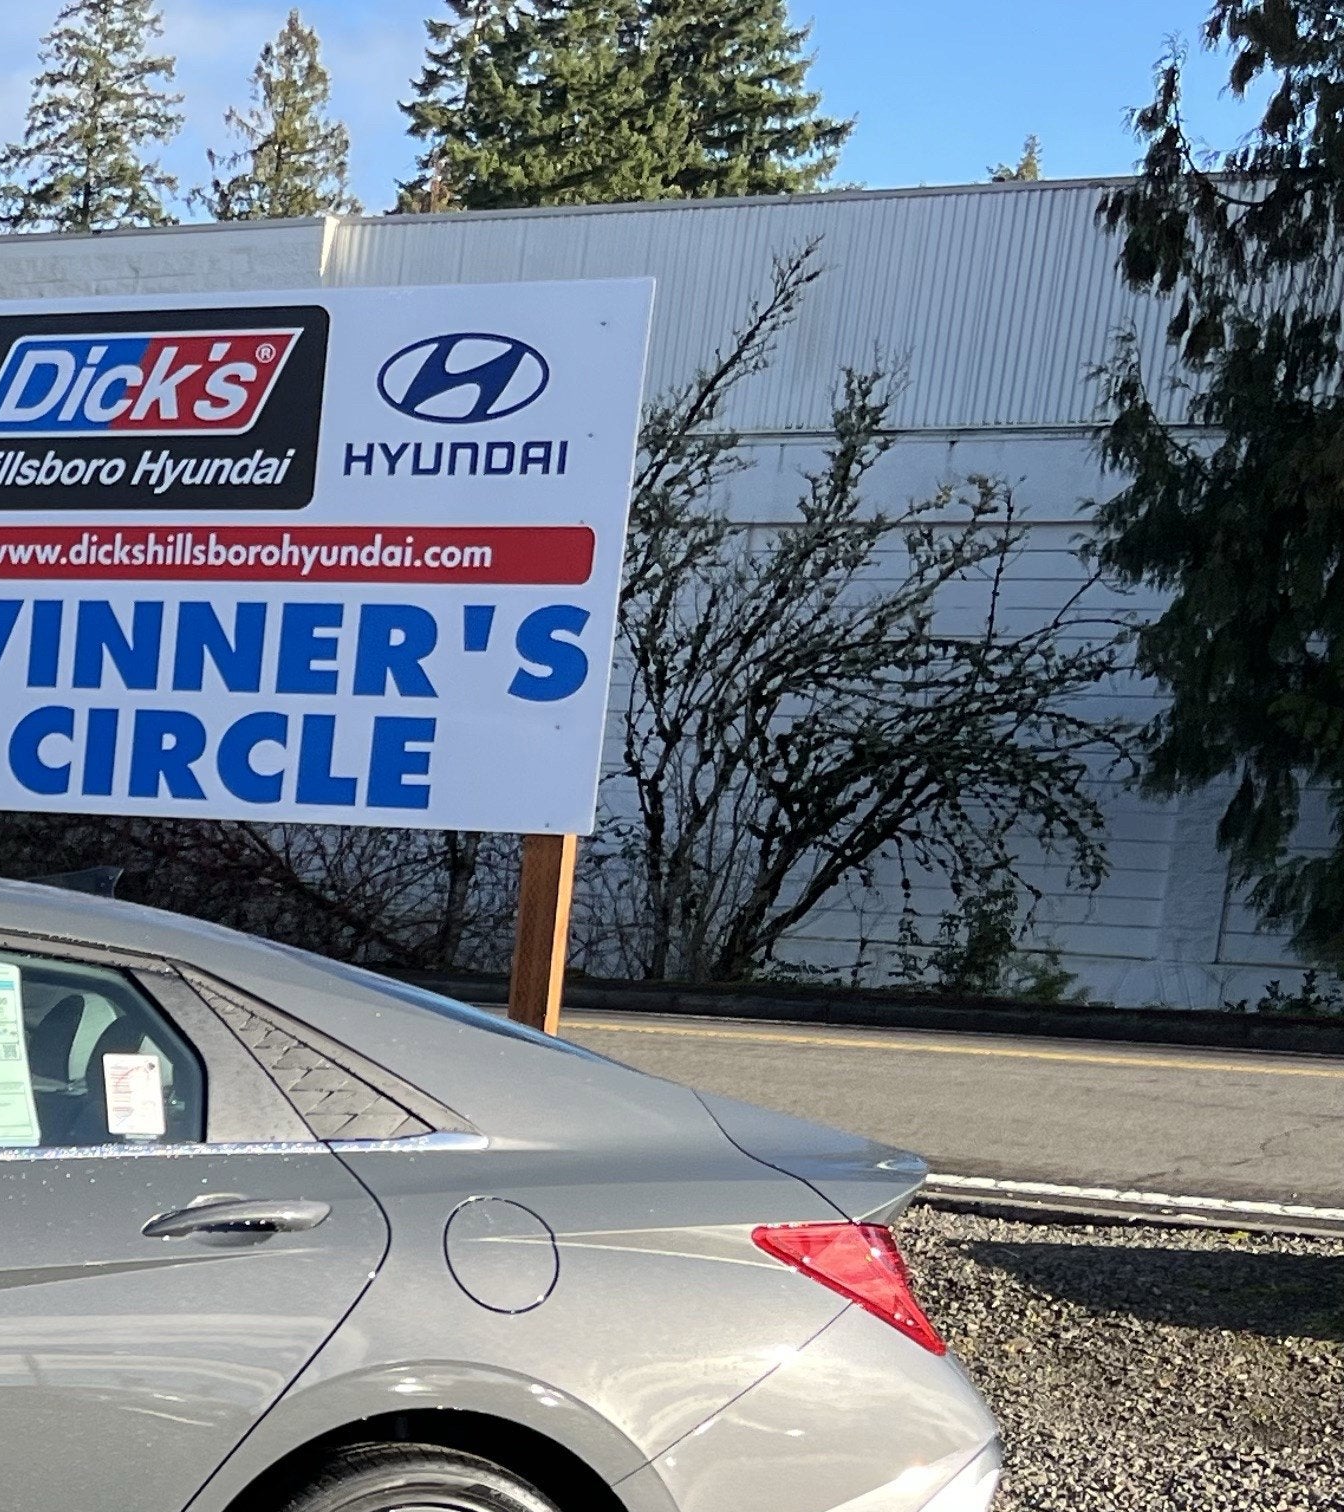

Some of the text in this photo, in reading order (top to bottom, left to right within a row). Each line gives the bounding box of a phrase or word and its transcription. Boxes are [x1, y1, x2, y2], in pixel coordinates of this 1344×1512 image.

[130, 448, 297, 495] Hyundai
[342, 440, 569, 476] HYUNDAI
[8, 705, 438, 810] CIRCLE
